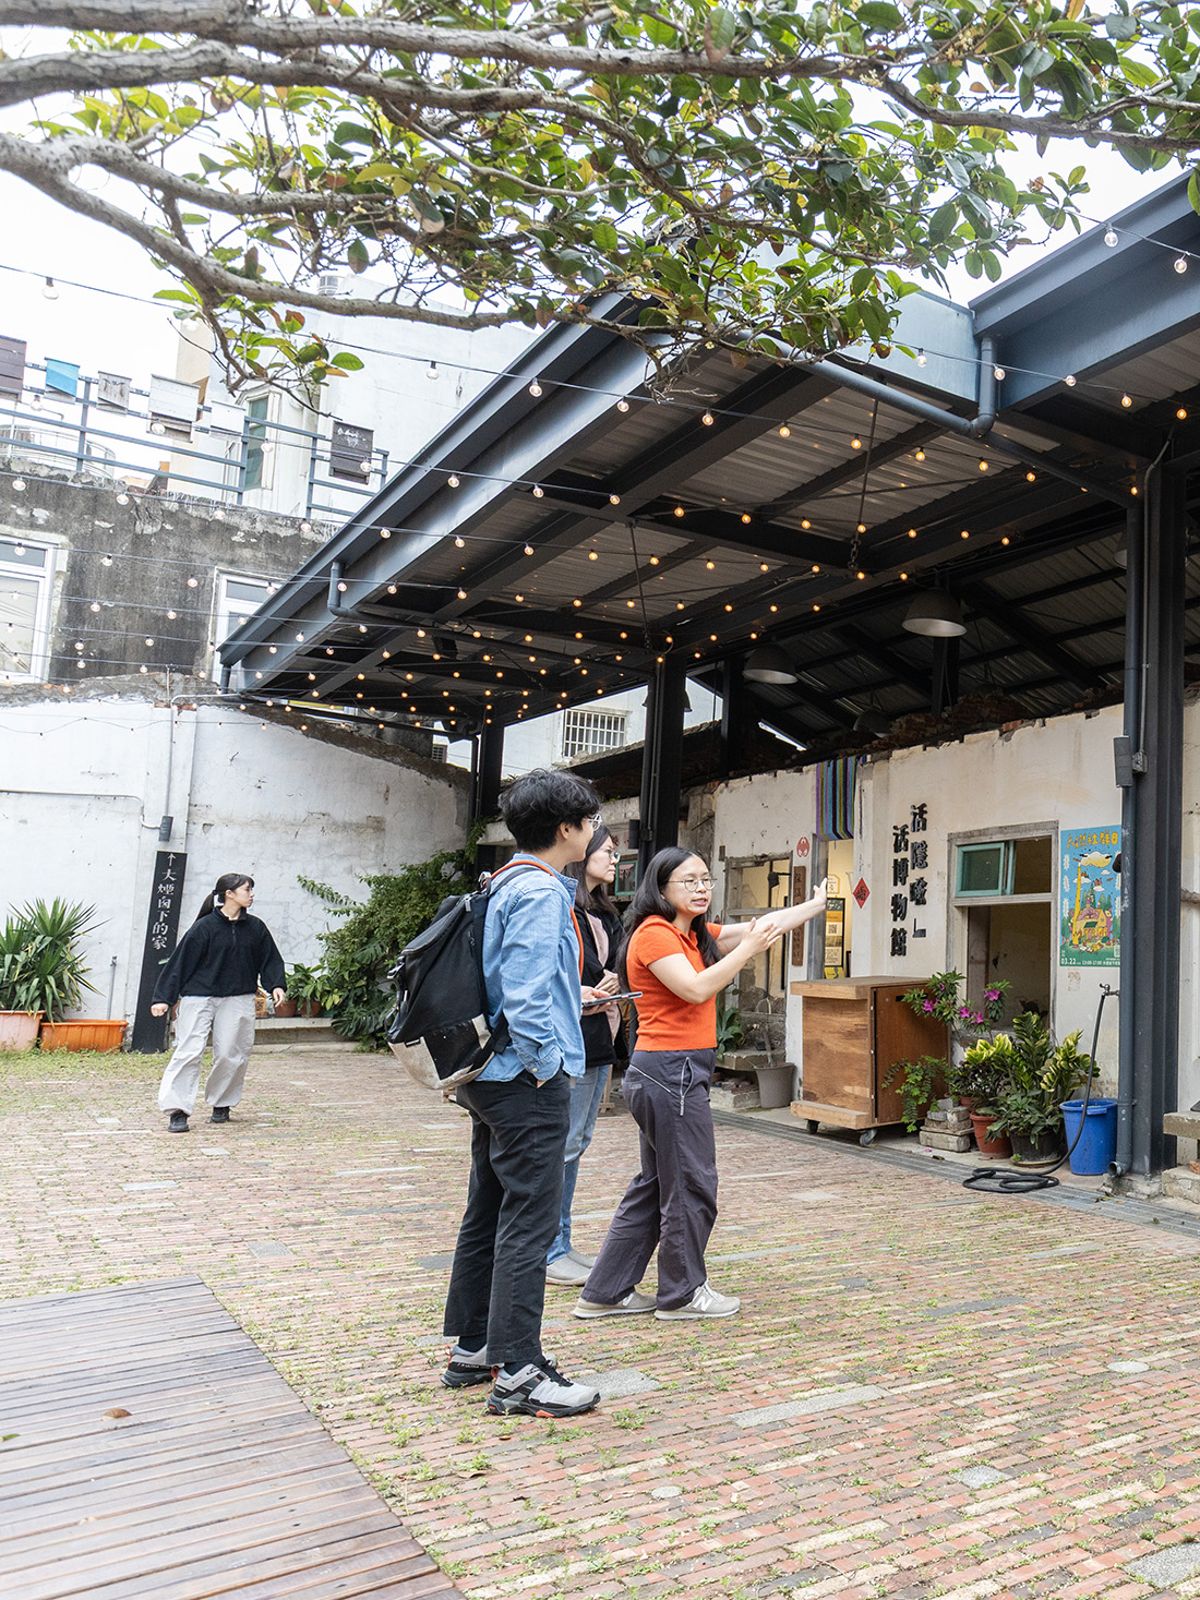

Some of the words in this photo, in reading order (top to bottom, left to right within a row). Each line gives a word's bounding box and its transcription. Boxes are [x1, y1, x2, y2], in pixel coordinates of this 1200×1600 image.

[152, 868, 177, 950] 大煙囪下的家
[890, 824, 910, 957] 活博物館
